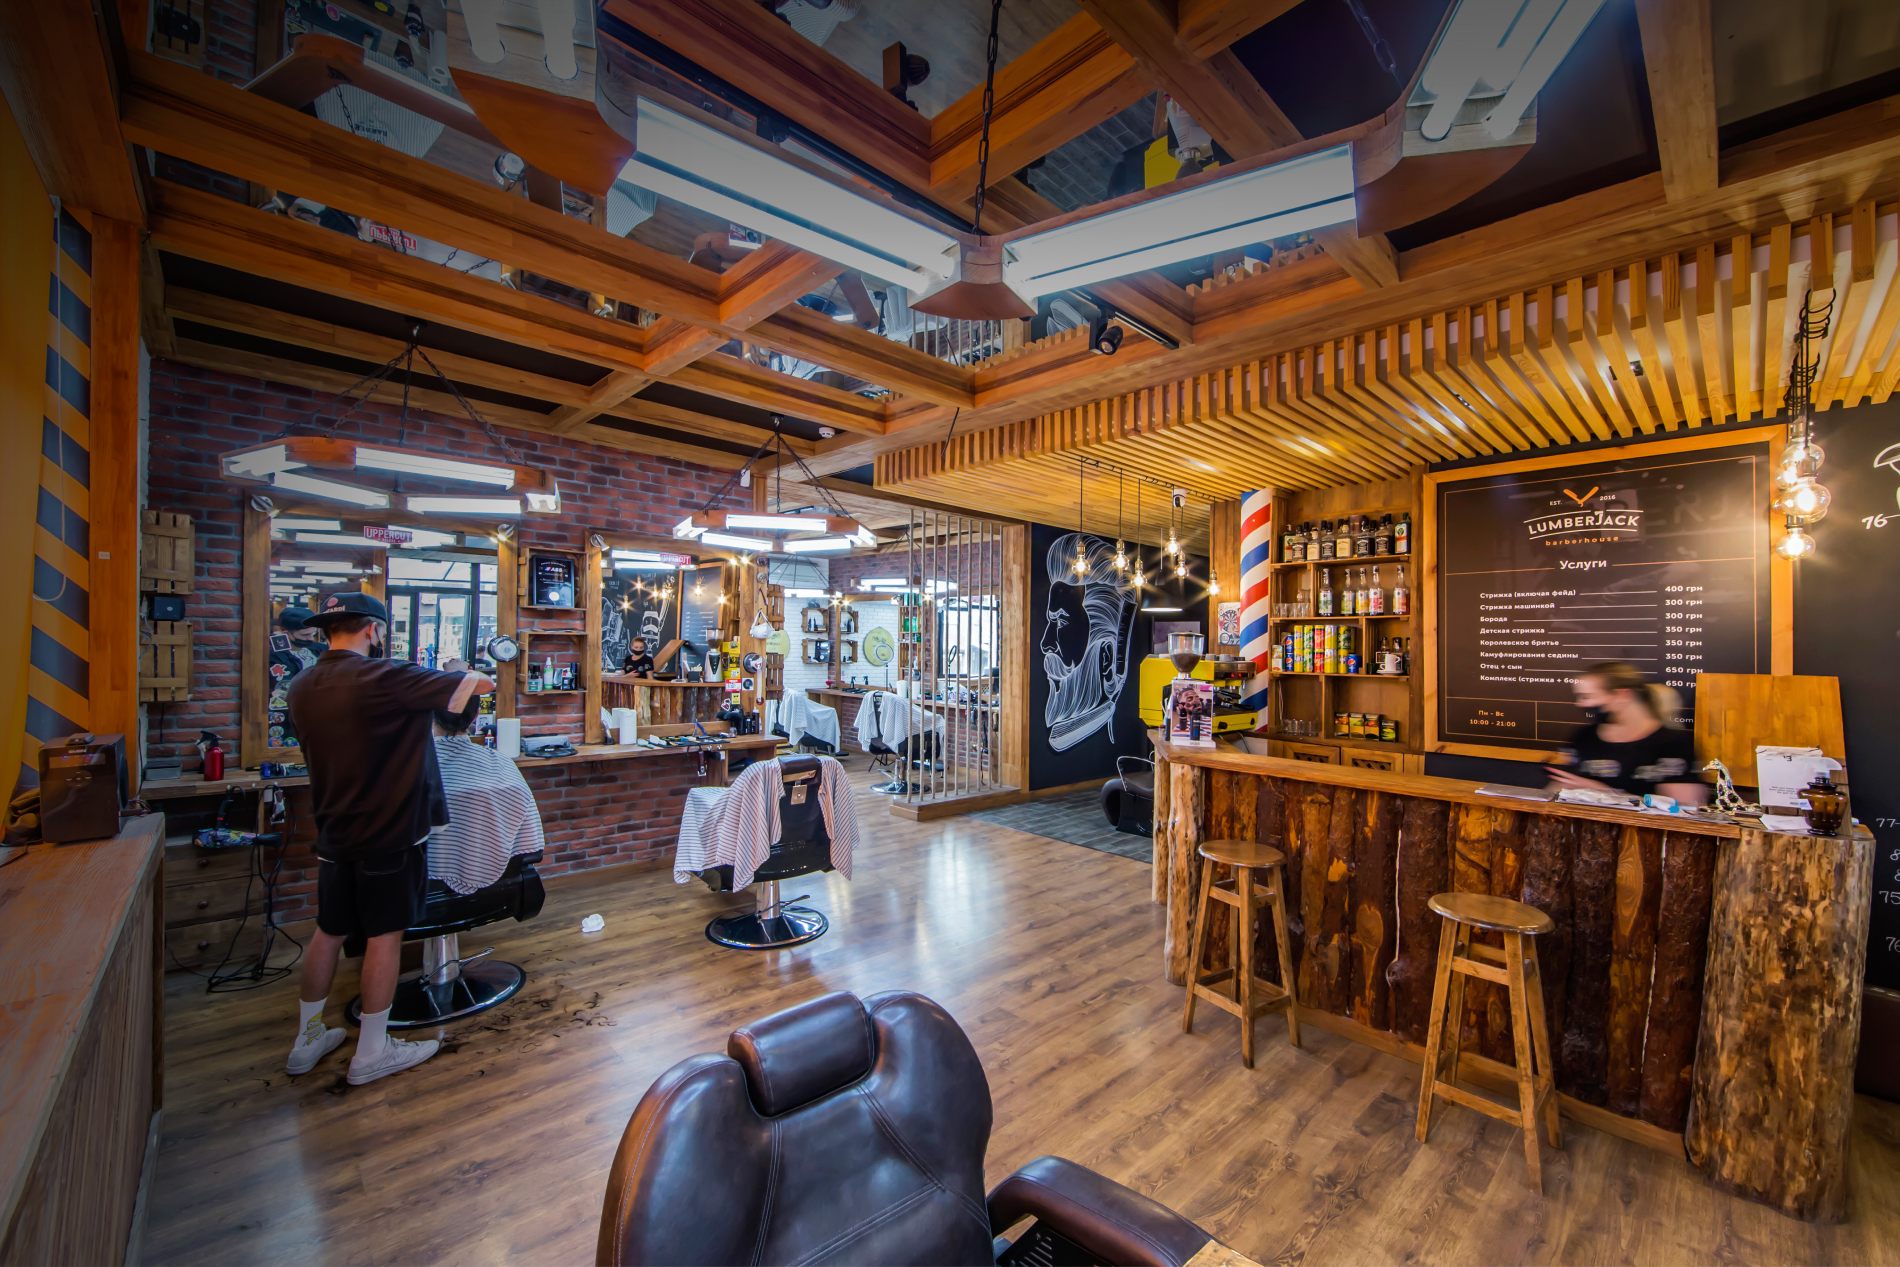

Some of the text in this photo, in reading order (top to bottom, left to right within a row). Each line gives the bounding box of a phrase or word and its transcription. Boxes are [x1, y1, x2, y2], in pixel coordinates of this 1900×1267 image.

[1528, 510, 1640, 535] LUMBERJACK
[366, 527, 412, 543] UPPERCUT
[1545, 536, 1619, 546] barberhouse
[1560, 560, 1607, 571] Услуги
[1480, 592, 1512, 600] Стрижка
[1551, 589, 1576, 597] фейд)
[1480, 651, 1545, 659] Камуфлирование
